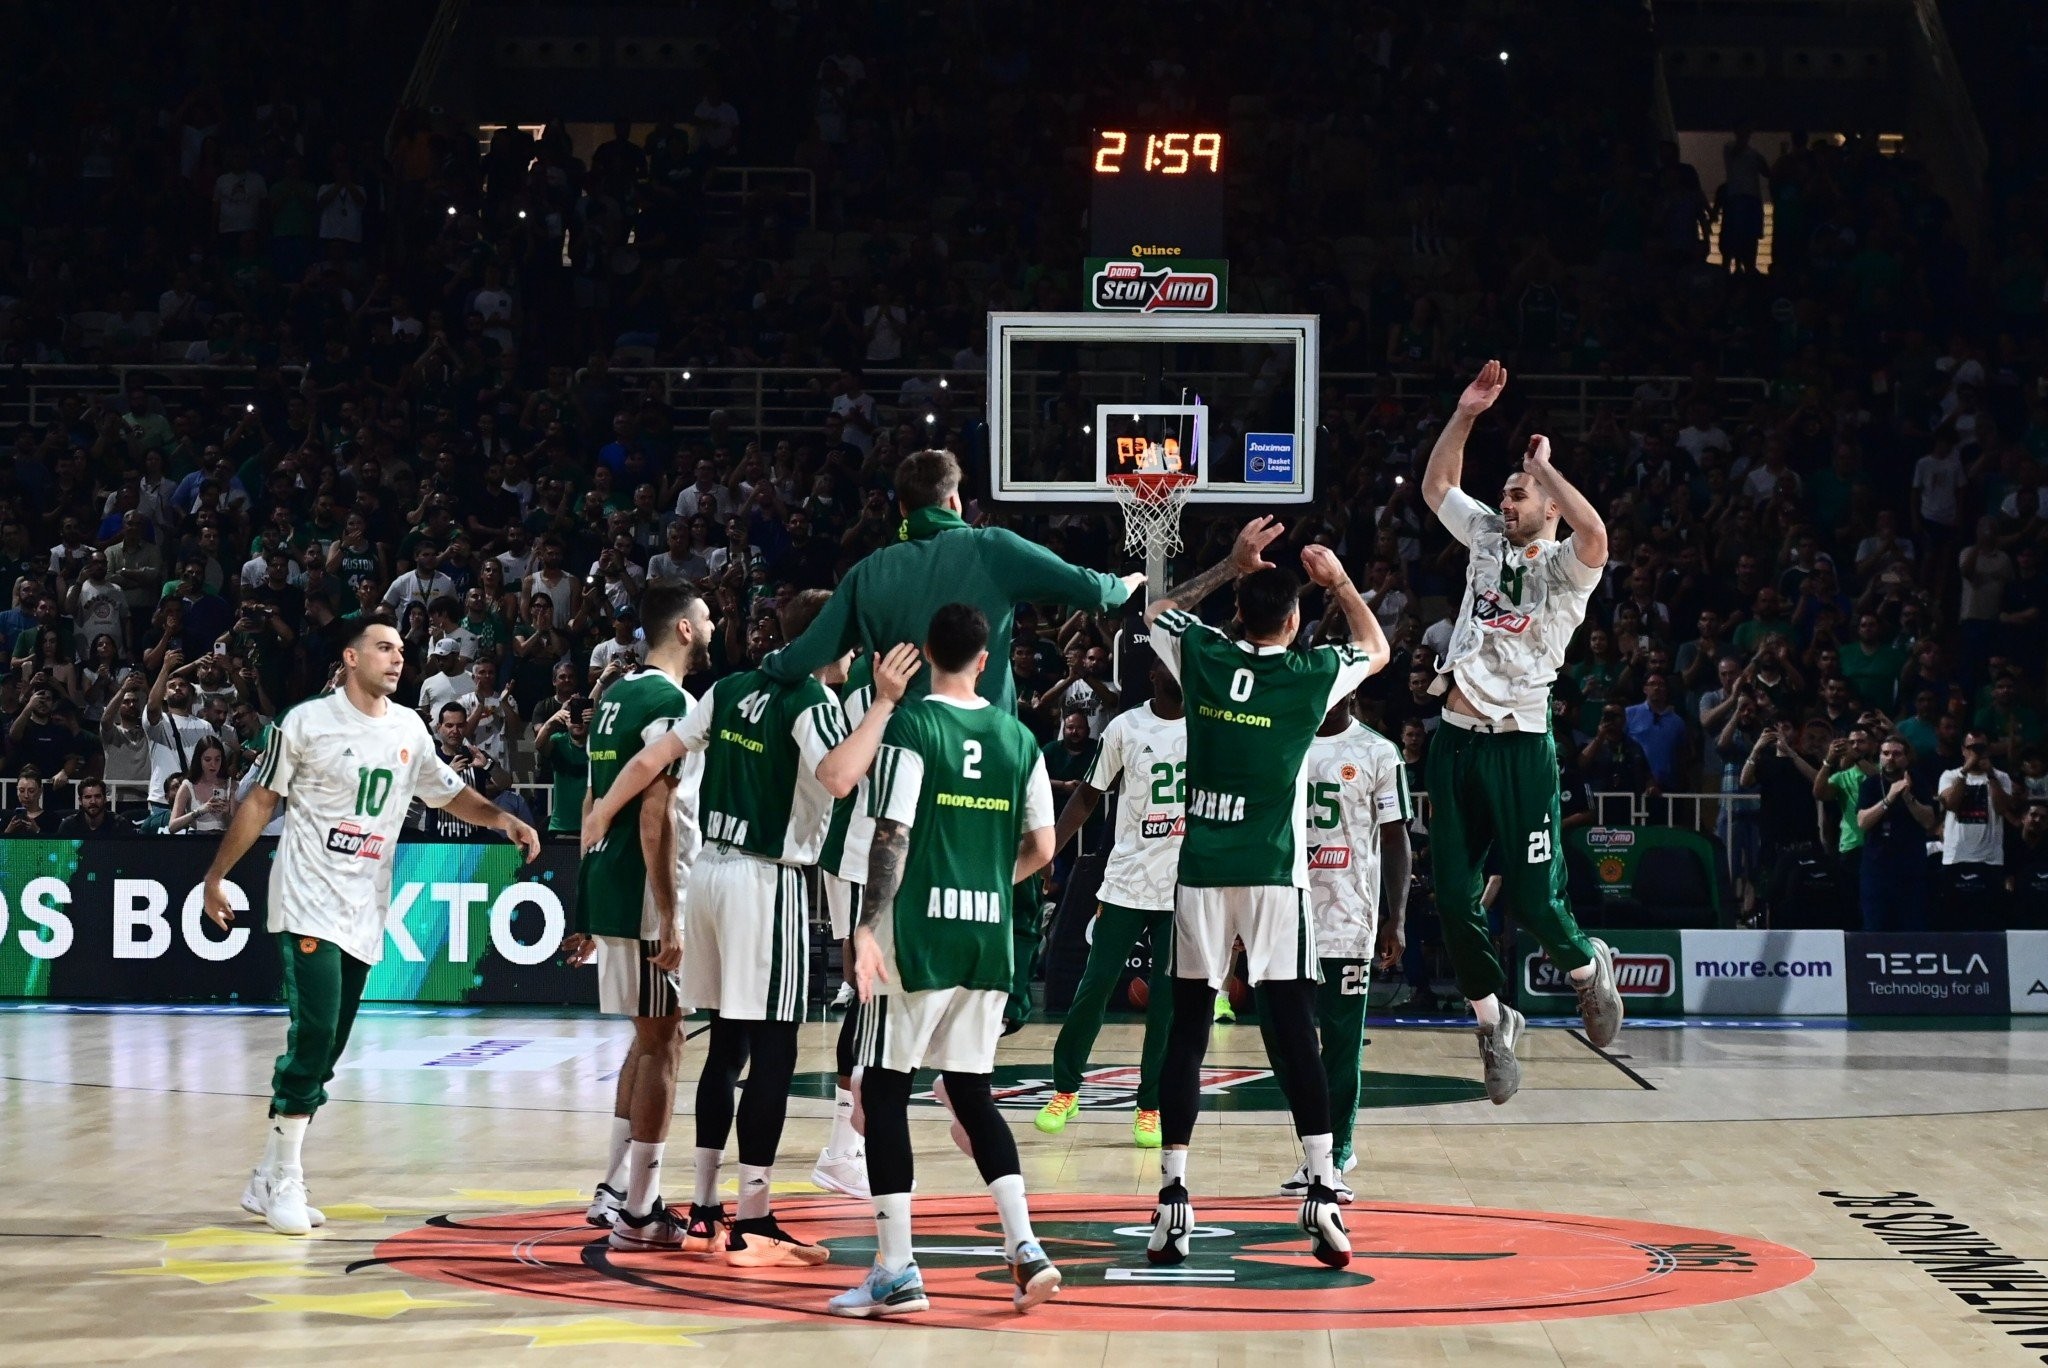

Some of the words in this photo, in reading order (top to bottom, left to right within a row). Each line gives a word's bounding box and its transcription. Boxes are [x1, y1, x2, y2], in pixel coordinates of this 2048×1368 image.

[1095, 131, 1221, 173] 21:59
[1131, 244, 1182, 257] Quince
[1109, 267, 1137, 278] pame
[1249, 442, 1291, 452] Stoiximan
[1268, 457, 1291, 465] Basket
[1268, 465, 1291, 473] League
[597, 701, 622, 735] 72
[737, 689, 771, 724] 40
[1199, 704, 1272, 728] more.com
[962, 739, 982, 779] 2
[354, 767, 393, 817] 10
[936, 791, 1010, 812] more.com
[1307, 781, 1340, 829] 5
[1527, 829, 1552, 864] 21
[0, 876, 74, 960] S
[113, 878, 251, 962] BC
[380, 882, 598, 965] KTO
[1695, 959, 1832, 978] more.com
[1866, 952, 1989, 975] TESLA
[1867, 980, 1949, 999] Technology
[1952, 980, 1971, 995] for
[1974, 981, 1990, 995] all
[1818, 1190, 1936, 1208] BC
